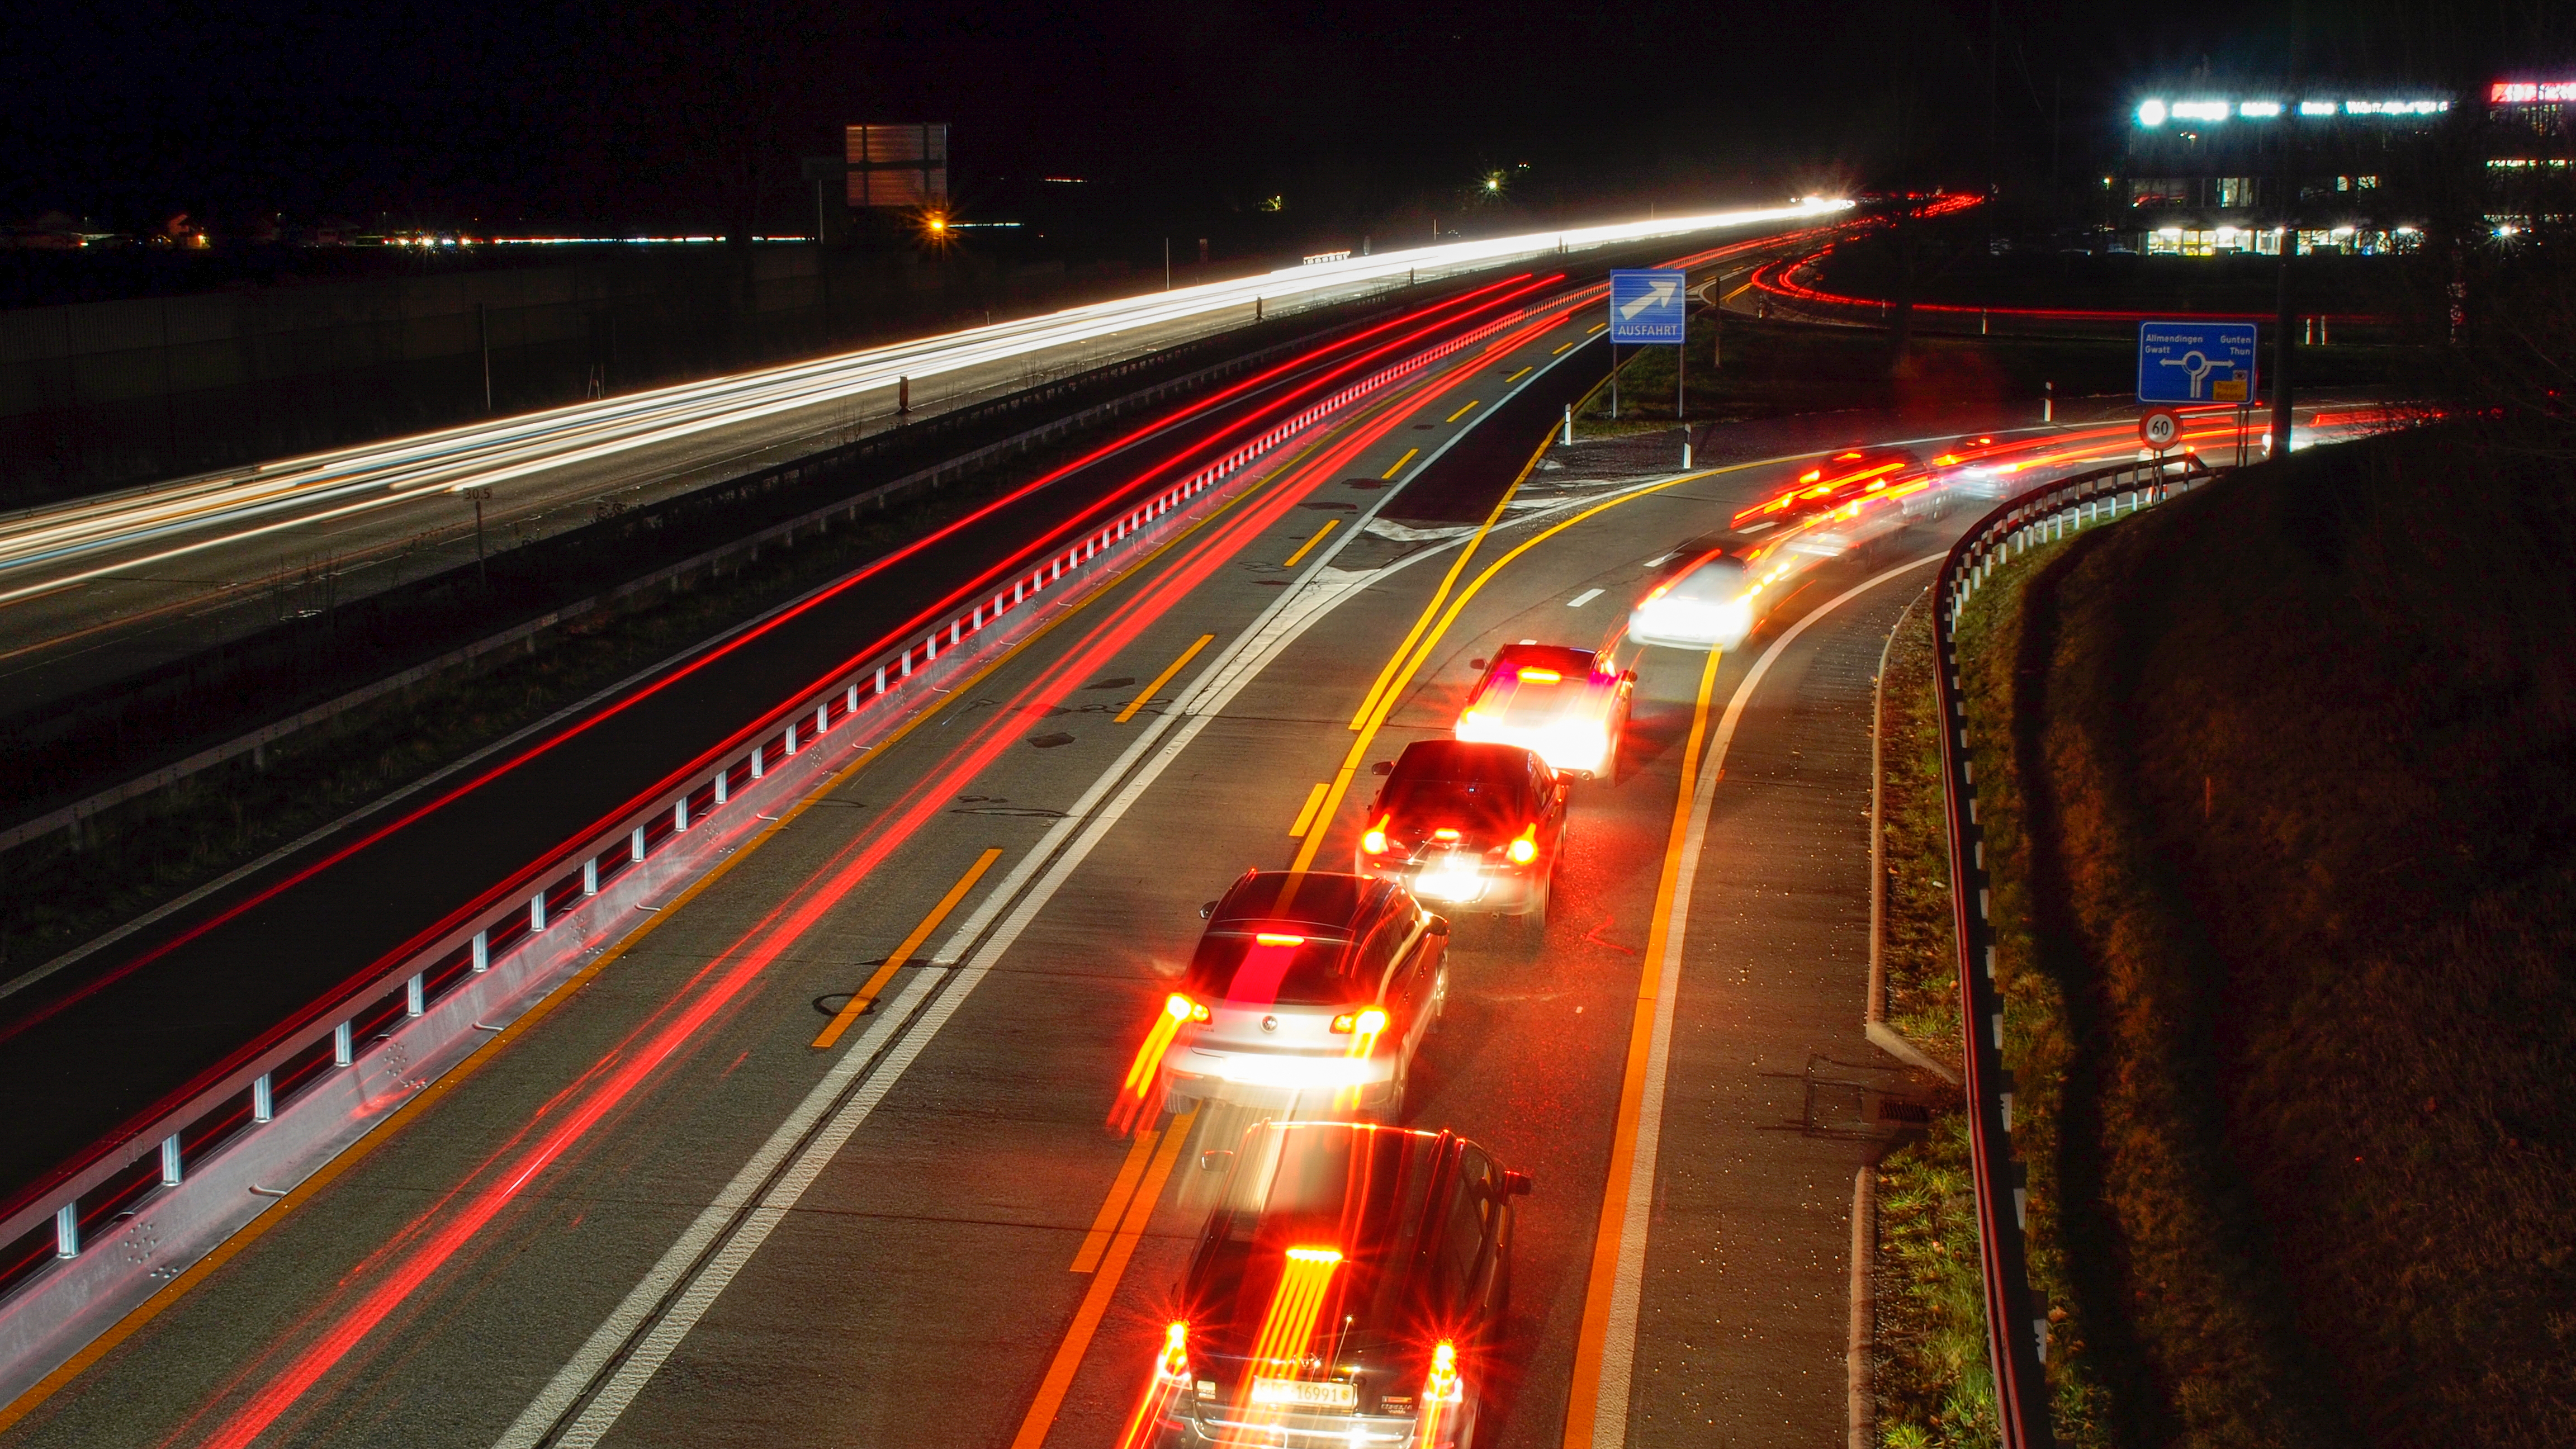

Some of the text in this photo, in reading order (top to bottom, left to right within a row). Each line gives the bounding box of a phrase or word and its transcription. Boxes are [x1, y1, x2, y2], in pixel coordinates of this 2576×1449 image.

[1618, 325, 1677, 335] AUSFAHRT
[2146, 334, 2203, 345] Allmendingen
[2220, 335, 2251, 344] Gunten
[2145, 345, 2170, 354] Gwatt
[2229, 347, 2251, 356] Thun
[2152, 420, 2168, 435] 60
[465, 488, 490, 500] 30.5
[1296, 1384, 1337, 1402] 16991
